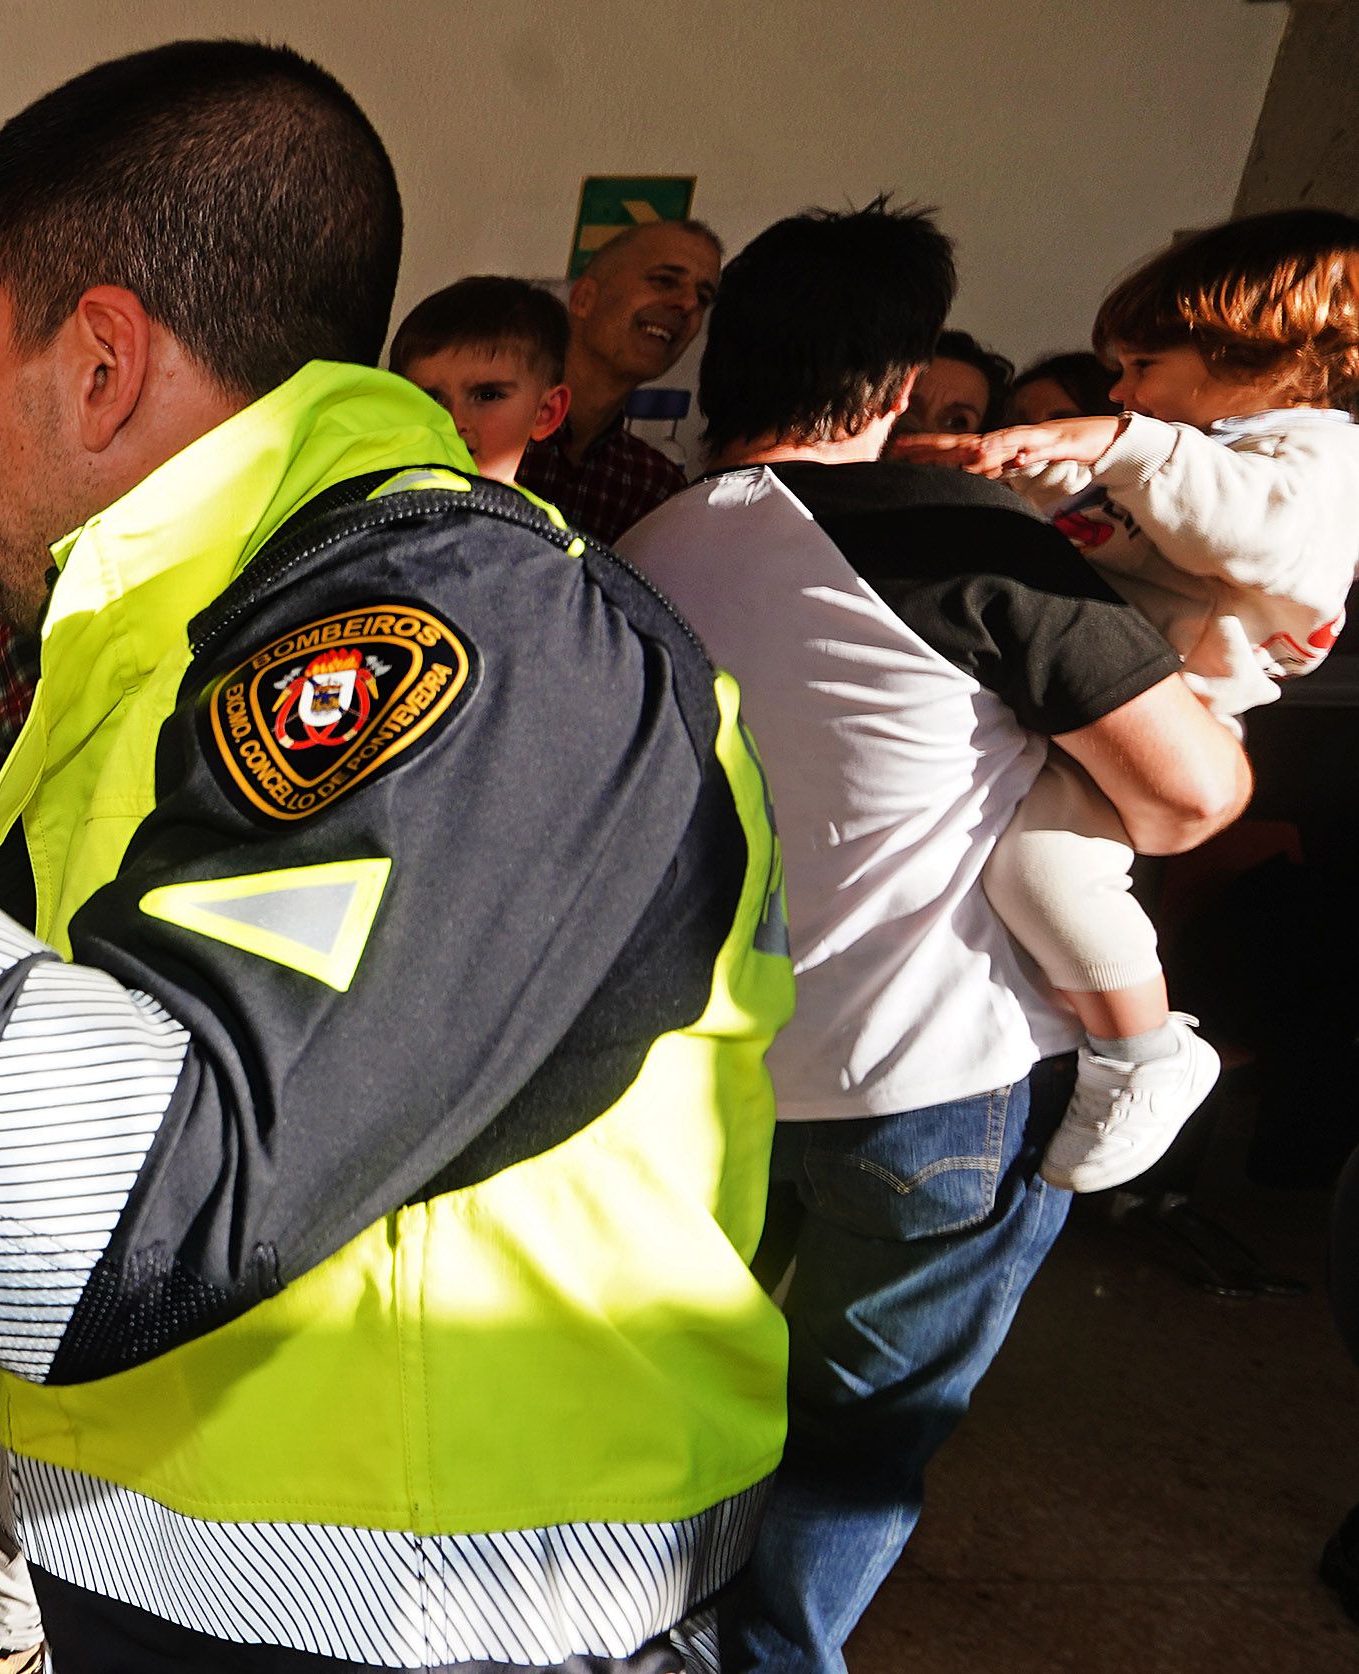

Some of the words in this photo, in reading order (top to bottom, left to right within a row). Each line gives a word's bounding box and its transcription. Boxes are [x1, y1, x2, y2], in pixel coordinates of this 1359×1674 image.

[252, 615, 443, 670] BOMBEIROS
[239, 739, 317, 810] CONCELLO
[317, 767, 350, 799] DE
[351, 662, 453, 772] PONTEVEDRA
